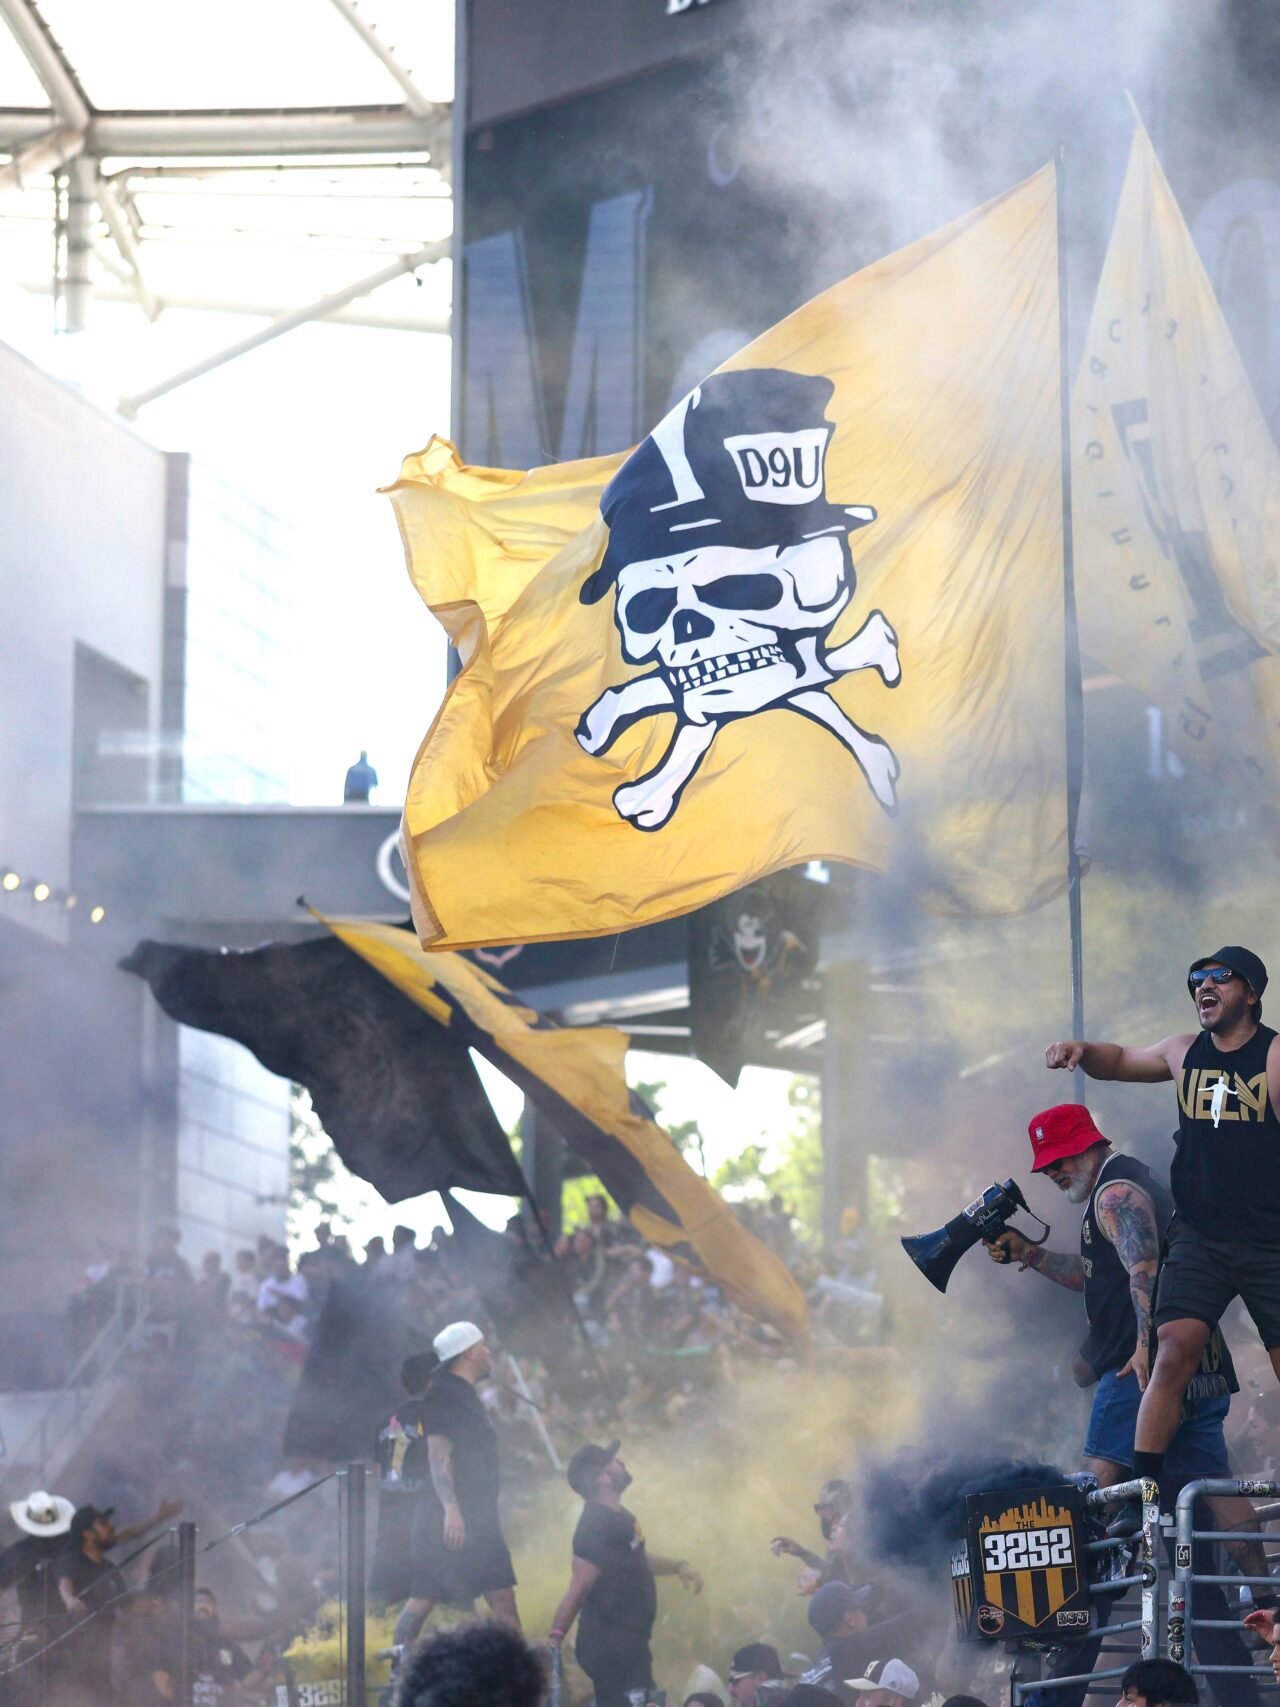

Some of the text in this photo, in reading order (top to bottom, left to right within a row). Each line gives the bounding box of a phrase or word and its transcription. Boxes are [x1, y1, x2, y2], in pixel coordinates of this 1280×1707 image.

[737, 445, 820, 489] D9U
[1015, 1519, 1036, 1529] THE
[984, 1527, 1073, 1572] 3252
